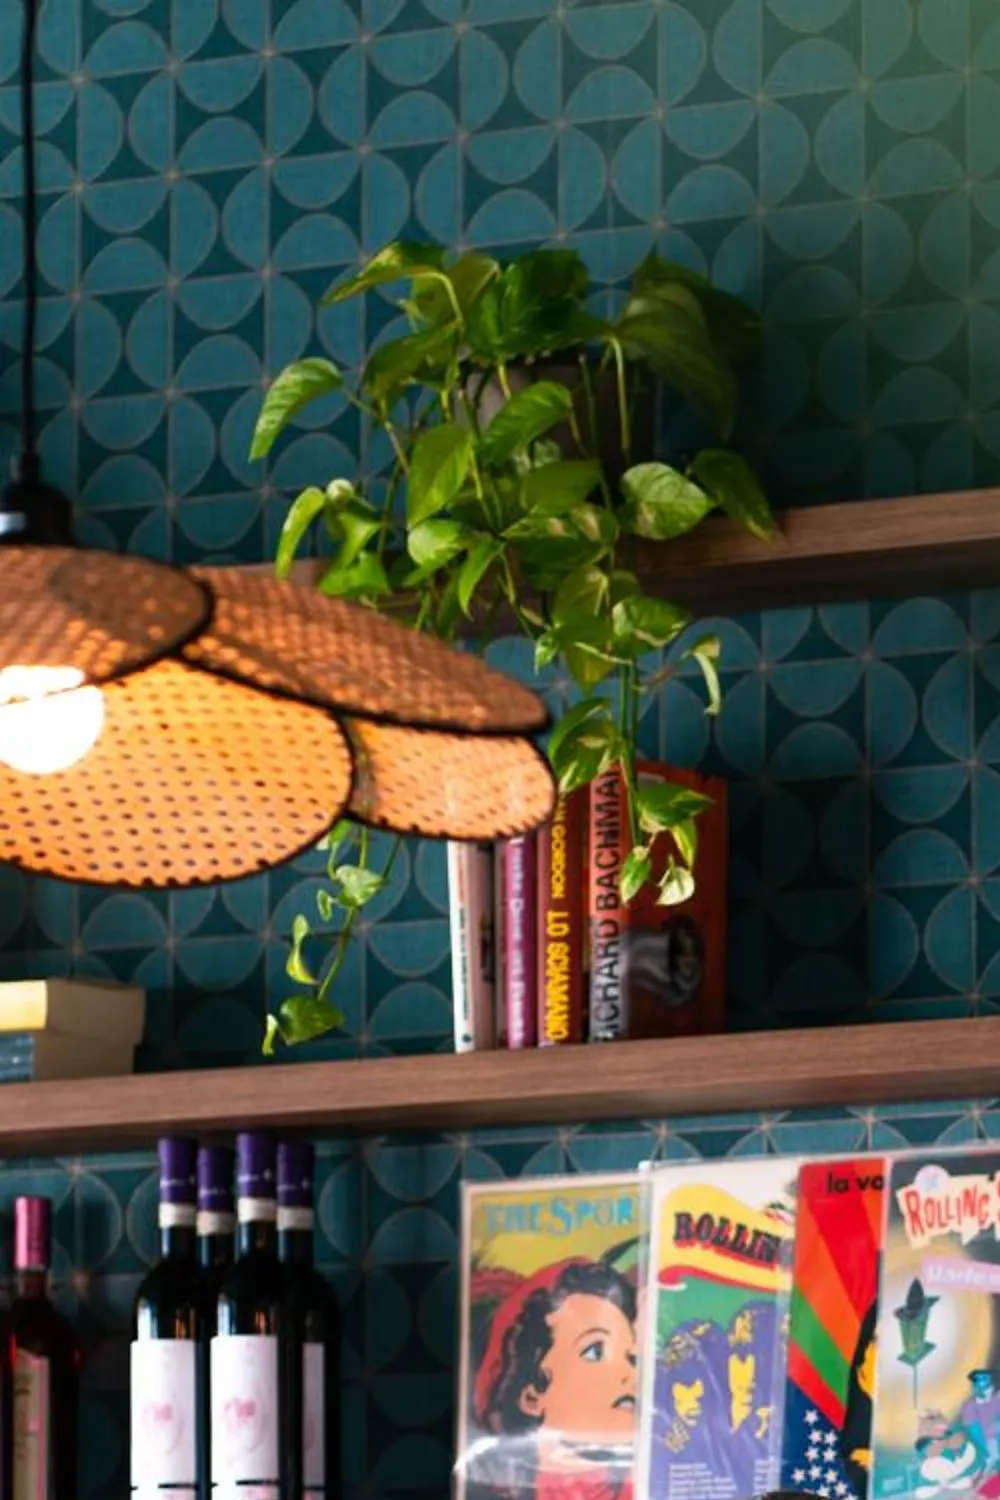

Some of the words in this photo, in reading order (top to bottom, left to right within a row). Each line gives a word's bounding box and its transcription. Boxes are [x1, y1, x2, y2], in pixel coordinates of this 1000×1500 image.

[551, 824, 567, 898] GORDON
[547, 910, 570, 937] LO
[545, 942, 571, 1041] SCIAMANO
[827, 1174, 850, 1193] la
[484, 1202, 542, 1235] THE
[904, 1185, 989, 1237] ROLLING
